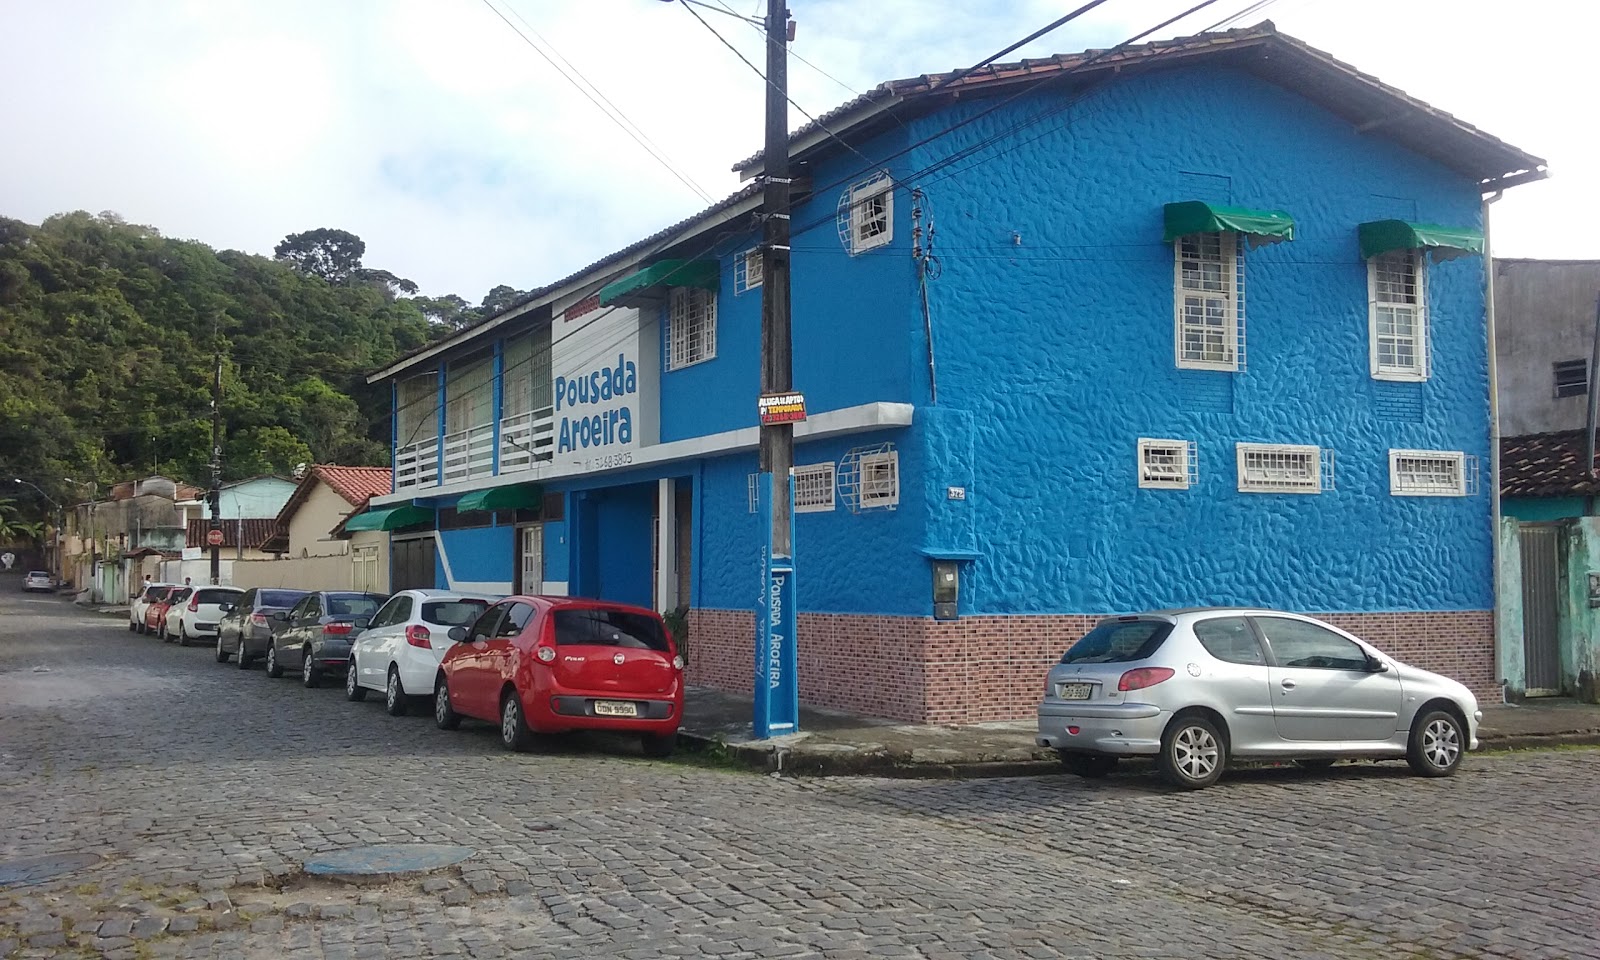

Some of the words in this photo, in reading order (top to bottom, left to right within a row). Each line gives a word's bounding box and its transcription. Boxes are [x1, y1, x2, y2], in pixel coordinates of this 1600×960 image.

[556, 353, 636, 411] Pousada
[558, 407, 632, 453] Aroeira
[771, 575, 785, 627] POUSADA
